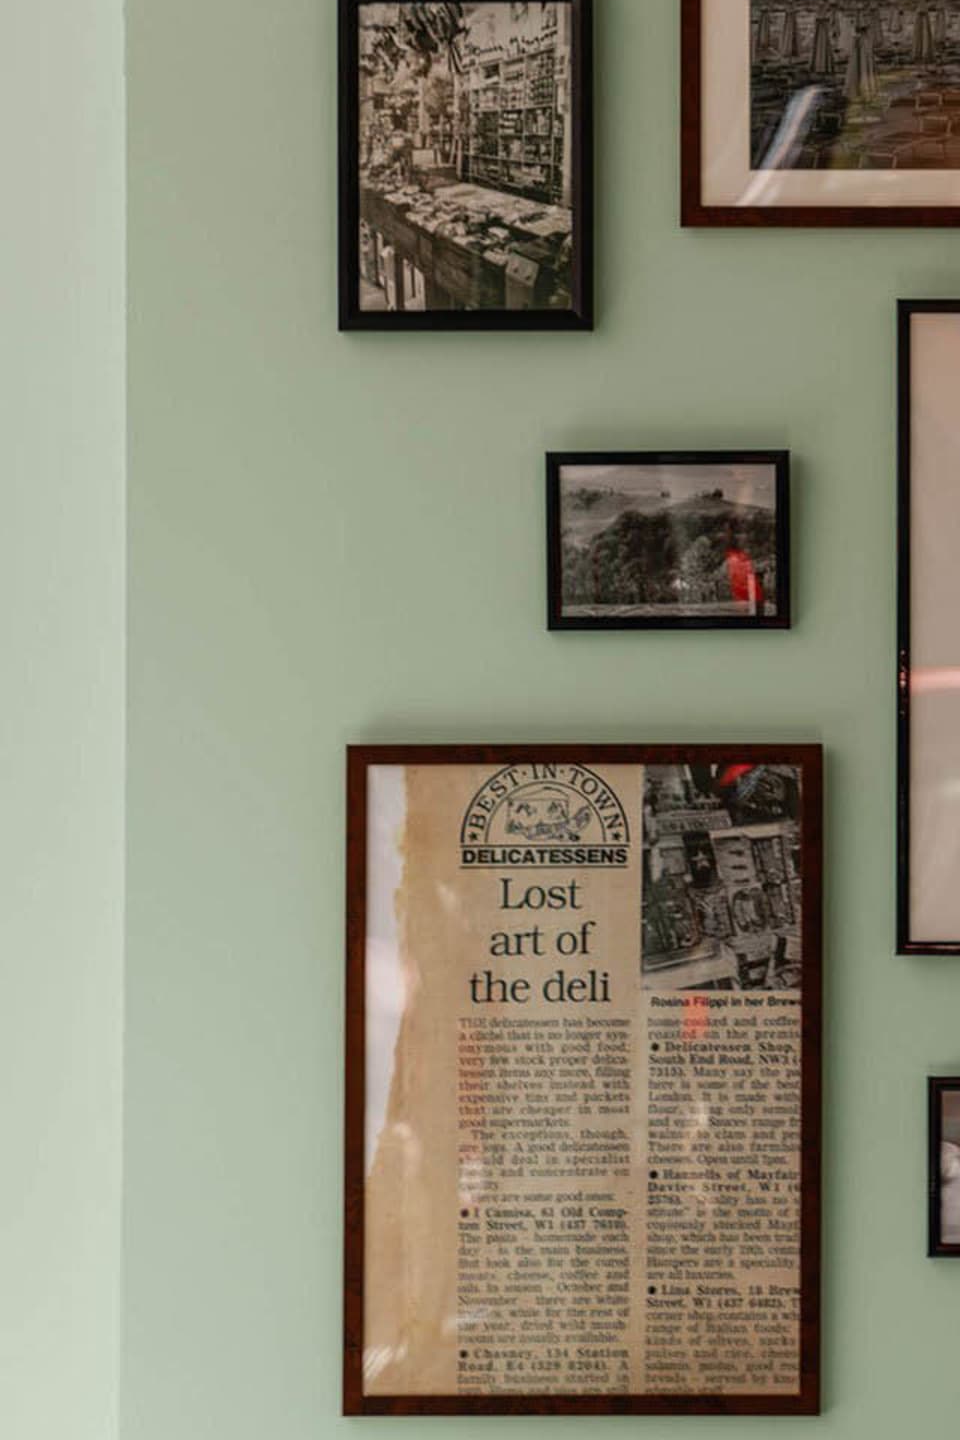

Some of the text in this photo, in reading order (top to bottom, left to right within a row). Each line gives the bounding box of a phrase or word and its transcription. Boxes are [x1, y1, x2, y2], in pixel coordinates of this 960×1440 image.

[468, 763, 624, 831] BEST IN TOWN
[461, 848, 628, 865] DELICATESSENS
[499, 877, 582, 910] Lost
[489, 920, 597, 957] art of
[468, 969, 612, 1004] the deli
